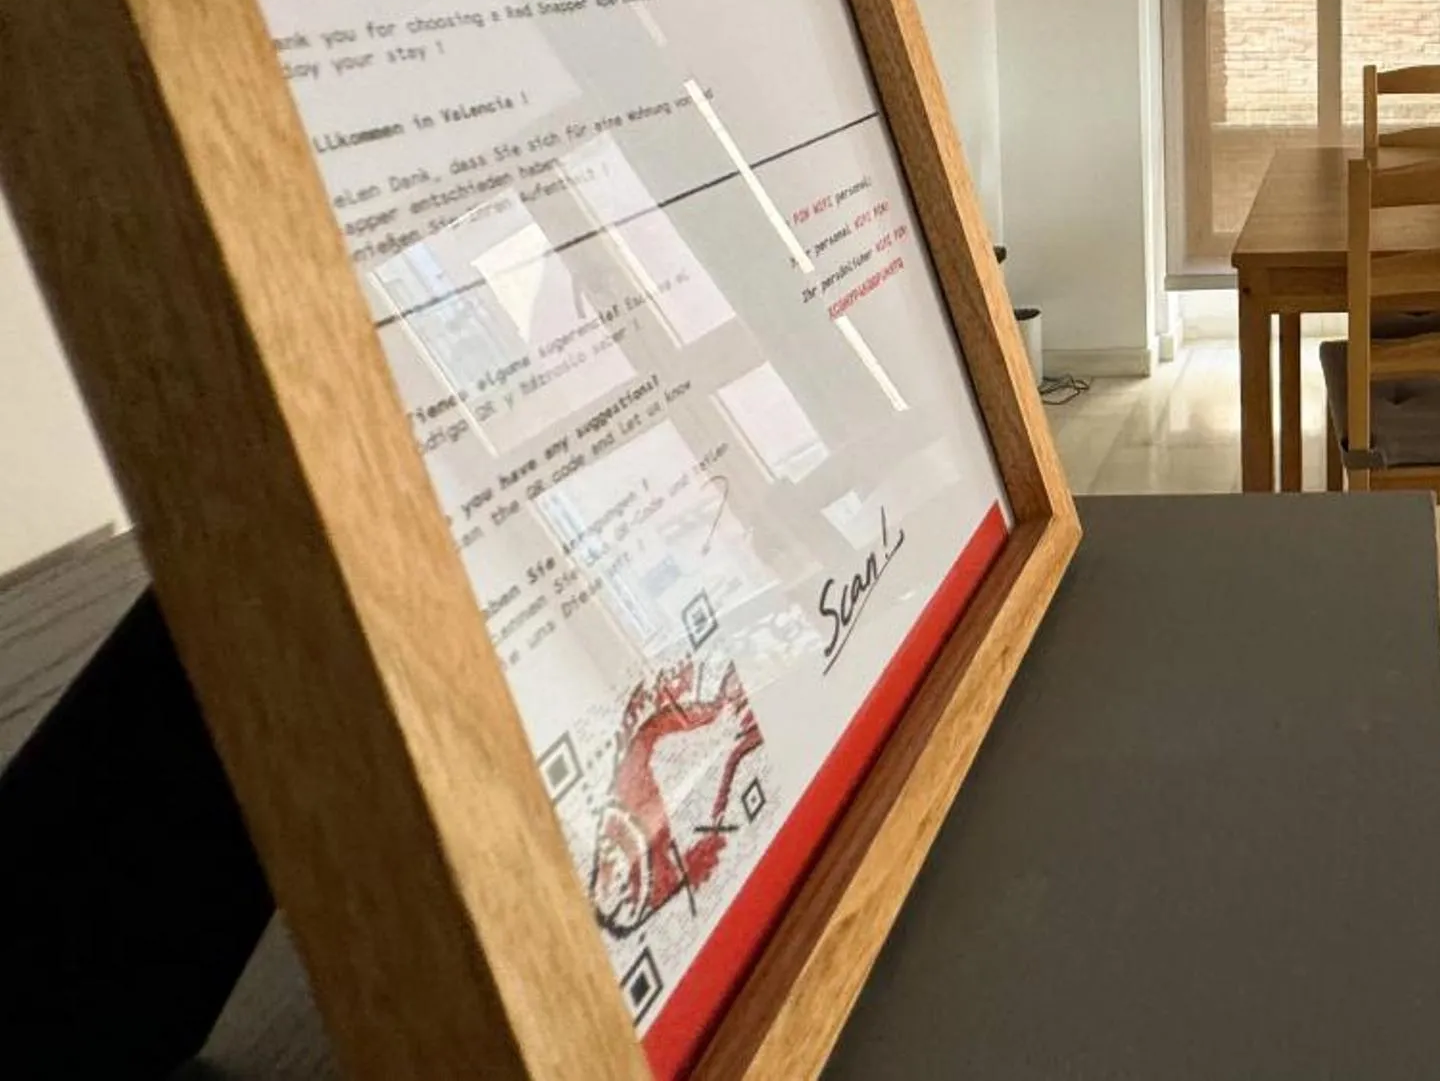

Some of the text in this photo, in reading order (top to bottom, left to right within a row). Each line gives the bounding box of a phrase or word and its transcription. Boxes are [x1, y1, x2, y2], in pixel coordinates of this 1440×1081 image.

[321, 29, 358, 50] you
[366, 20, 397, 39] for
[313, 123, 405, 154] llkommen
